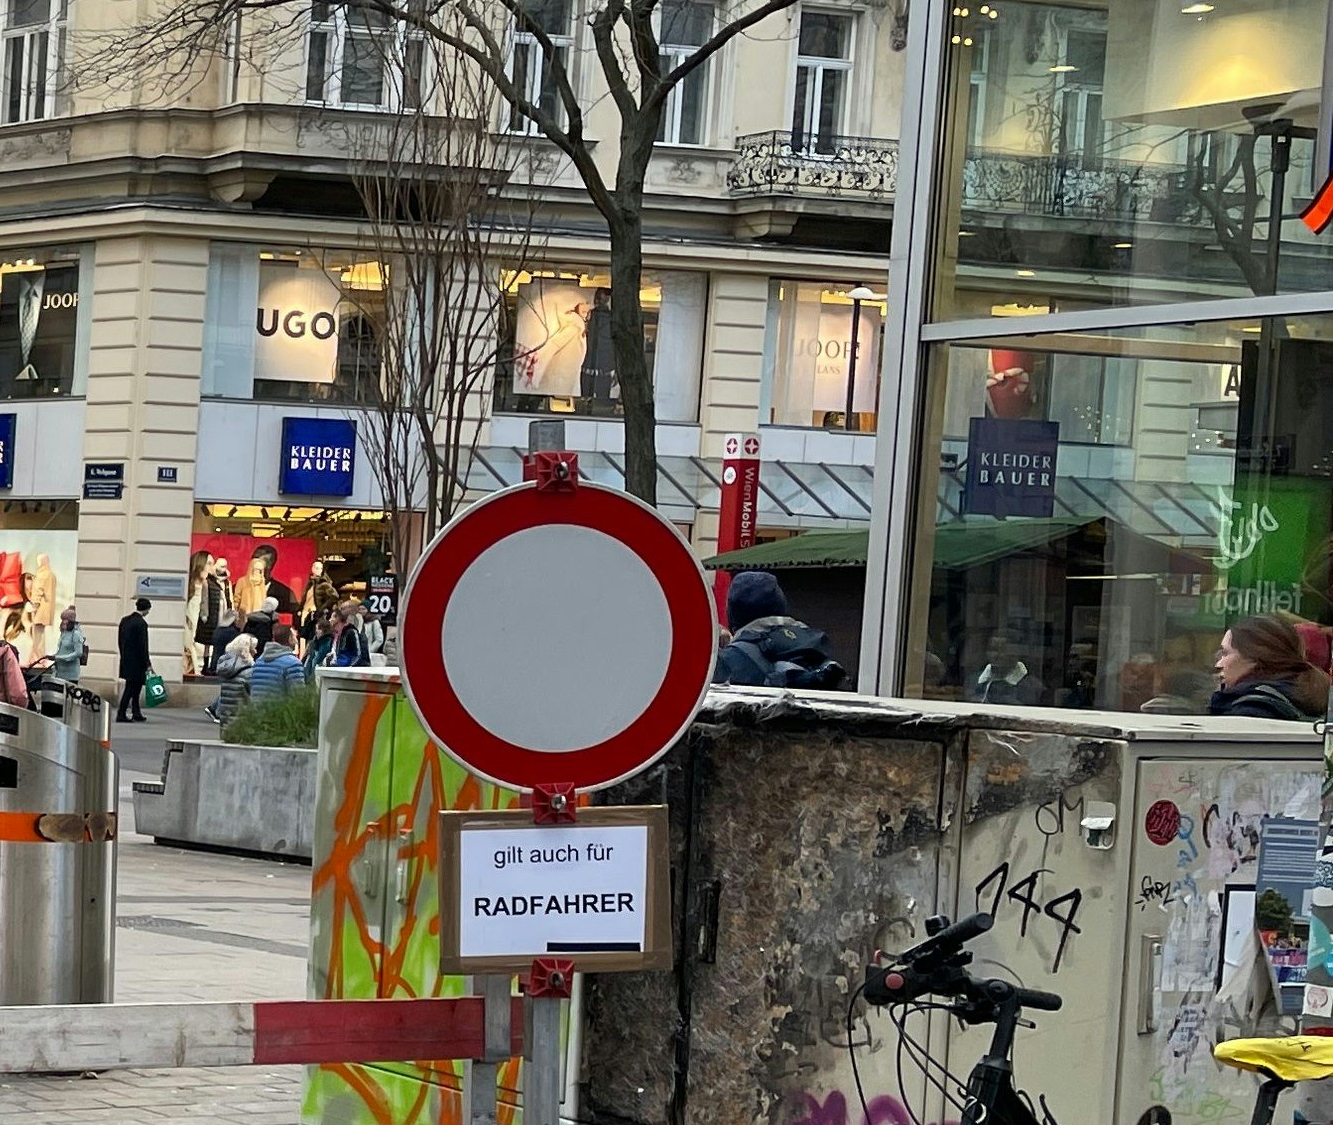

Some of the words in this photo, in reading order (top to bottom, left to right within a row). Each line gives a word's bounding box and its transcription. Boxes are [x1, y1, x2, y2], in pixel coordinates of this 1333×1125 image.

[290, 445, 351, 460] KLEIDER
[980, 452, 1052, 469] KLEIDER
[290, 458, 350, 472] BAUER
[980, 470, 1050, 486] BAUER
[741, 467, 756, 537] WienMobil
[494, 846, 523, 869] gilt
[530, 844, 579, 863] auch
[587, 843, 614, 861] für
[474, 893, 634, 917] RADFAHRER
